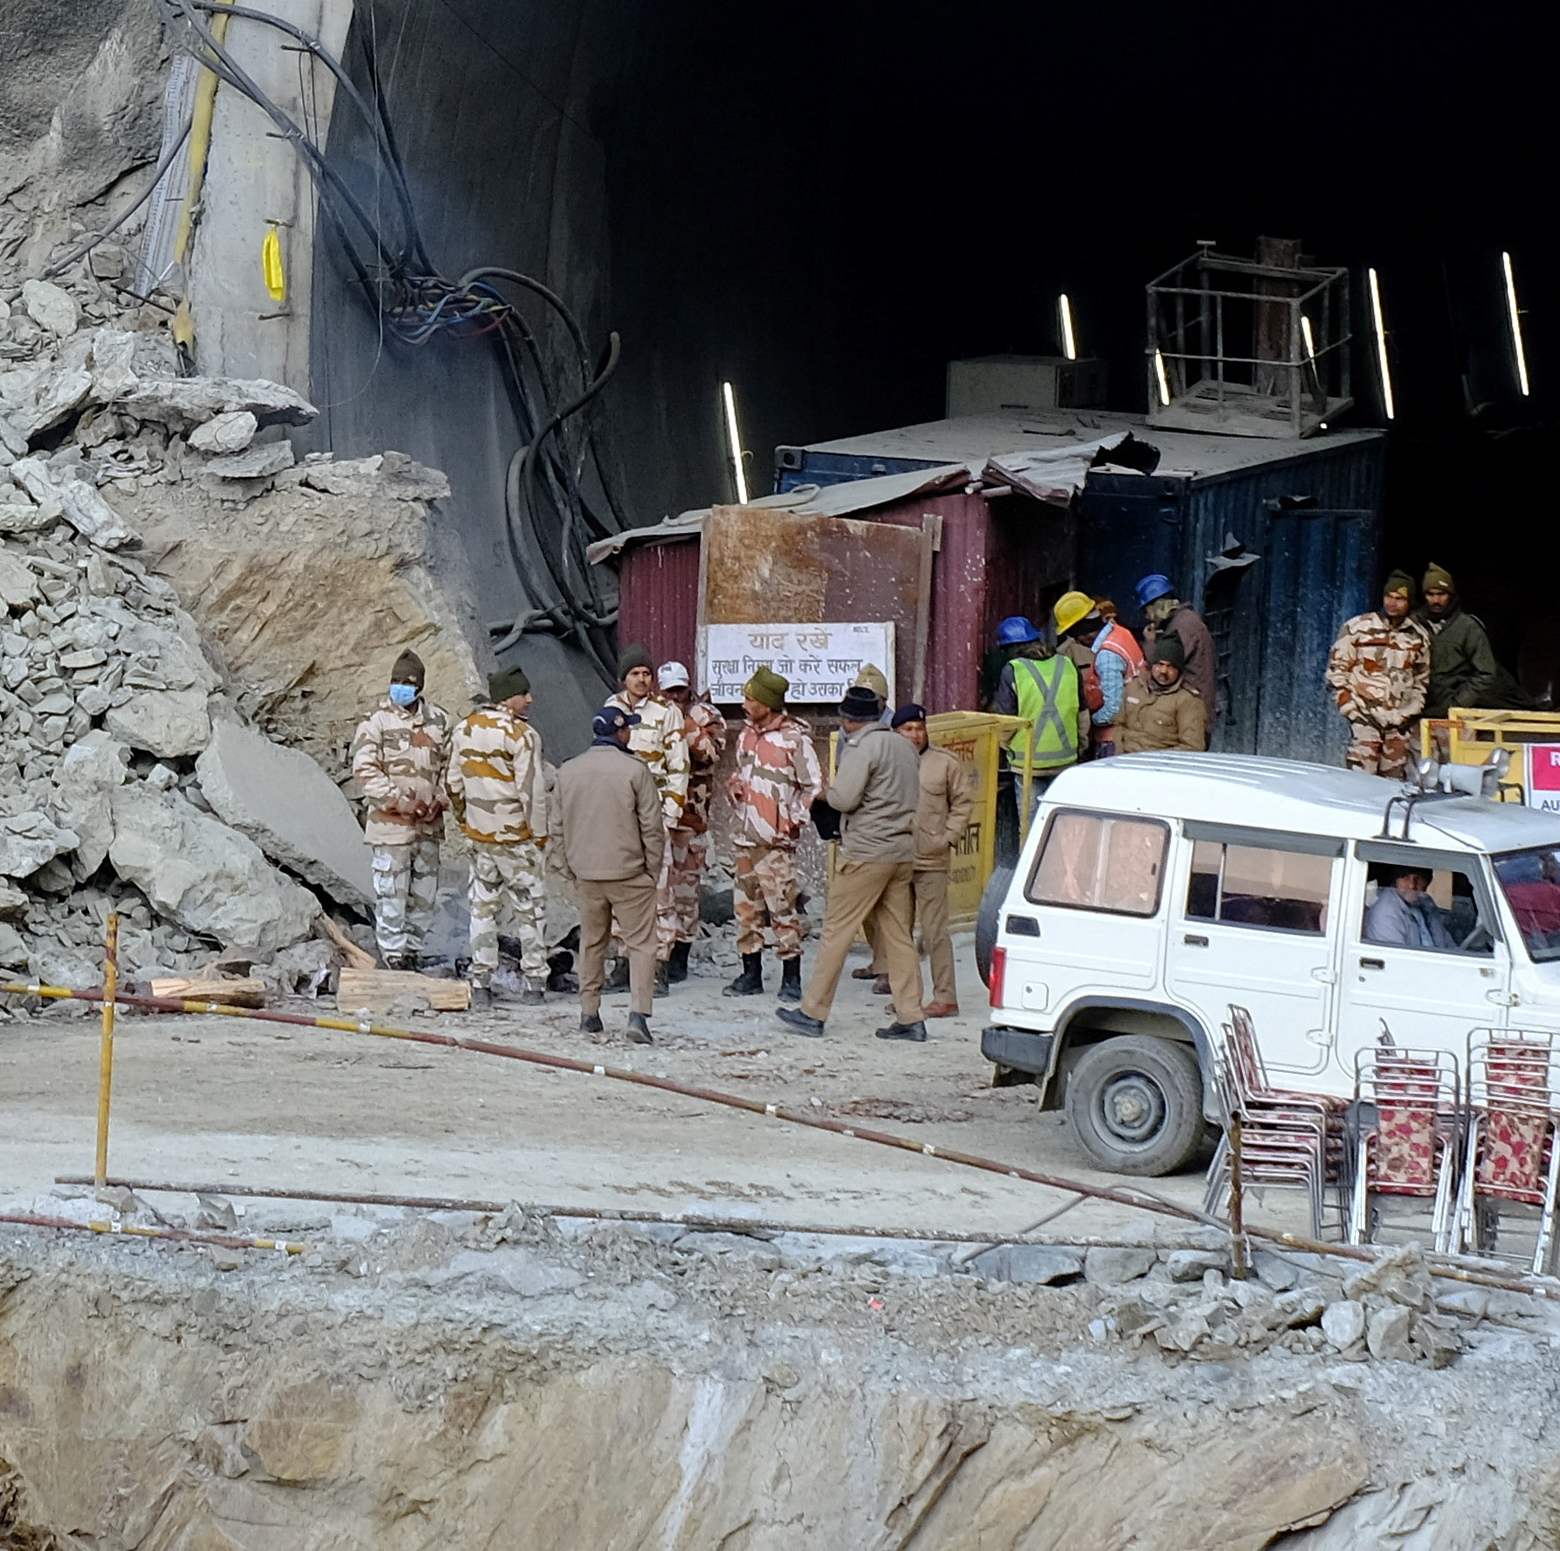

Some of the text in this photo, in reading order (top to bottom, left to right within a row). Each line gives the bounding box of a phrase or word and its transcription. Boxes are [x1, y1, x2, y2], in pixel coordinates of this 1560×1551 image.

[748, 631, 789, 651] याद
[711, 659, 741, 679] सुरक्षा
[776, 655, 794, 674] जो
[799, 655, 822, 675] करें
[790, 679, 808, 700] हो
